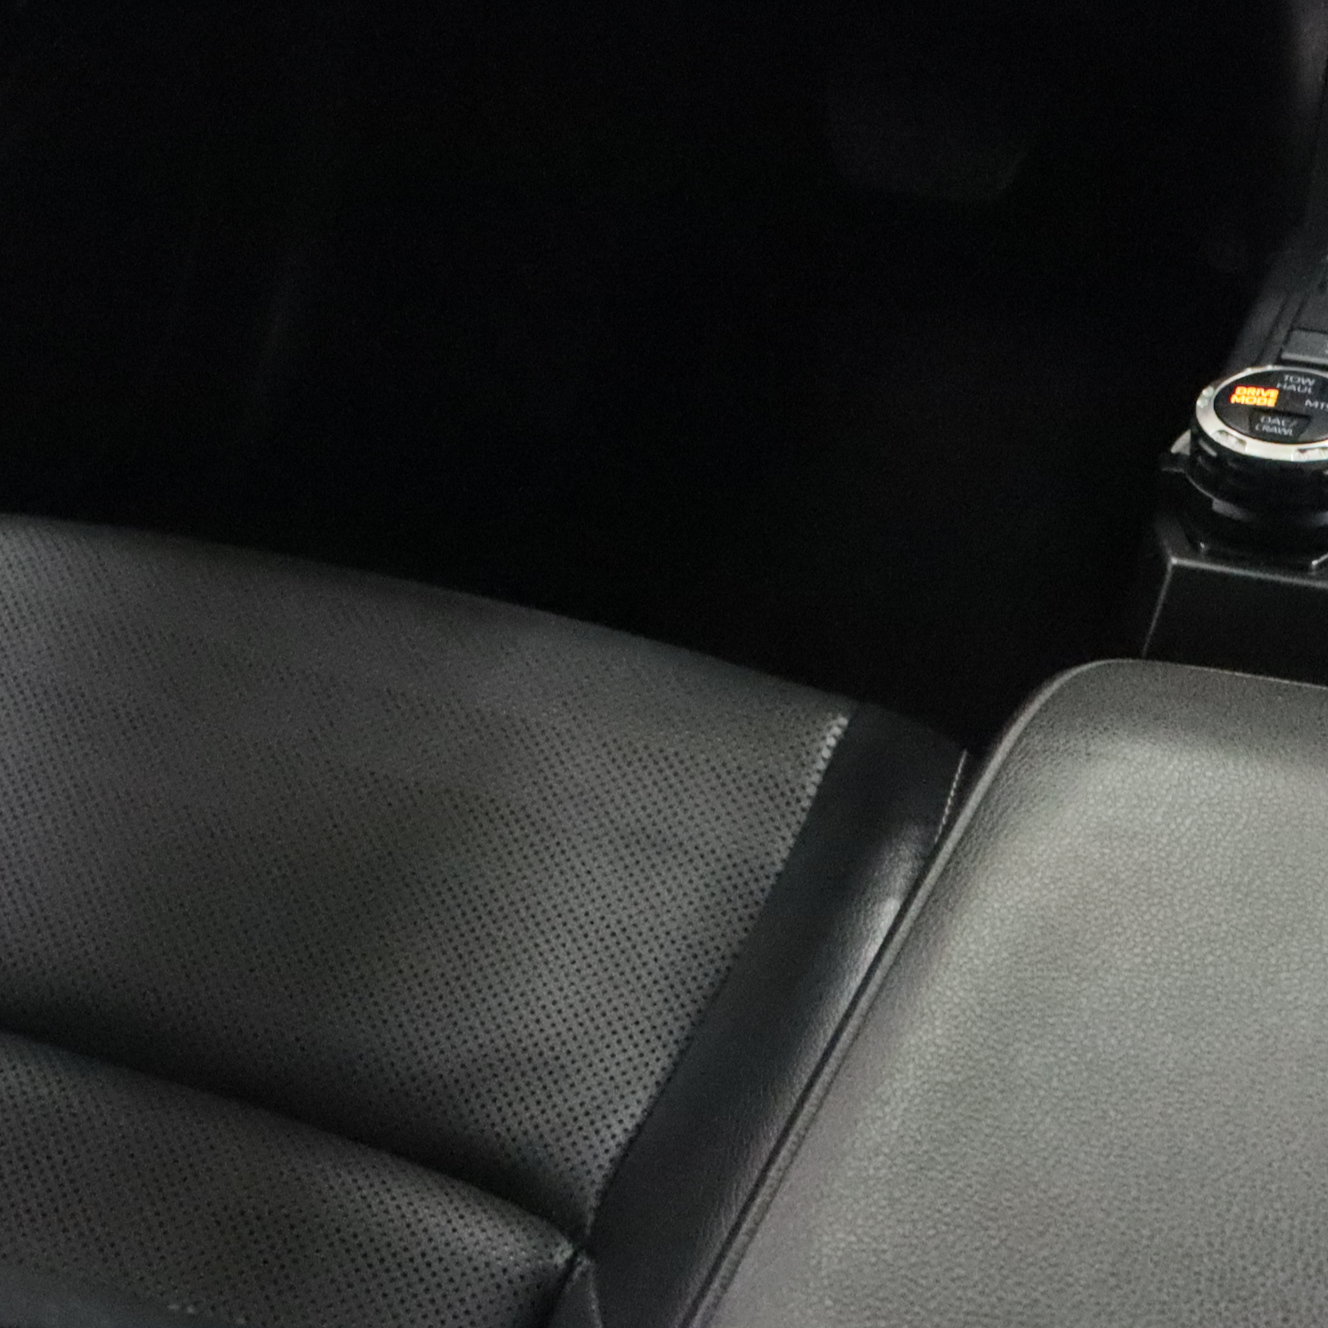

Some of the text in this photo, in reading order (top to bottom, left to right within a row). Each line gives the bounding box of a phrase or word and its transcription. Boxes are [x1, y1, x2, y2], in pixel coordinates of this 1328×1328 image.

[1283, 373, 1316, 387] TOW
[1234, 385, 1280, 399] DRIVE
[1276, 382, 1313, 395] HAUL
[1229, 394, 1278, 409] MODE
